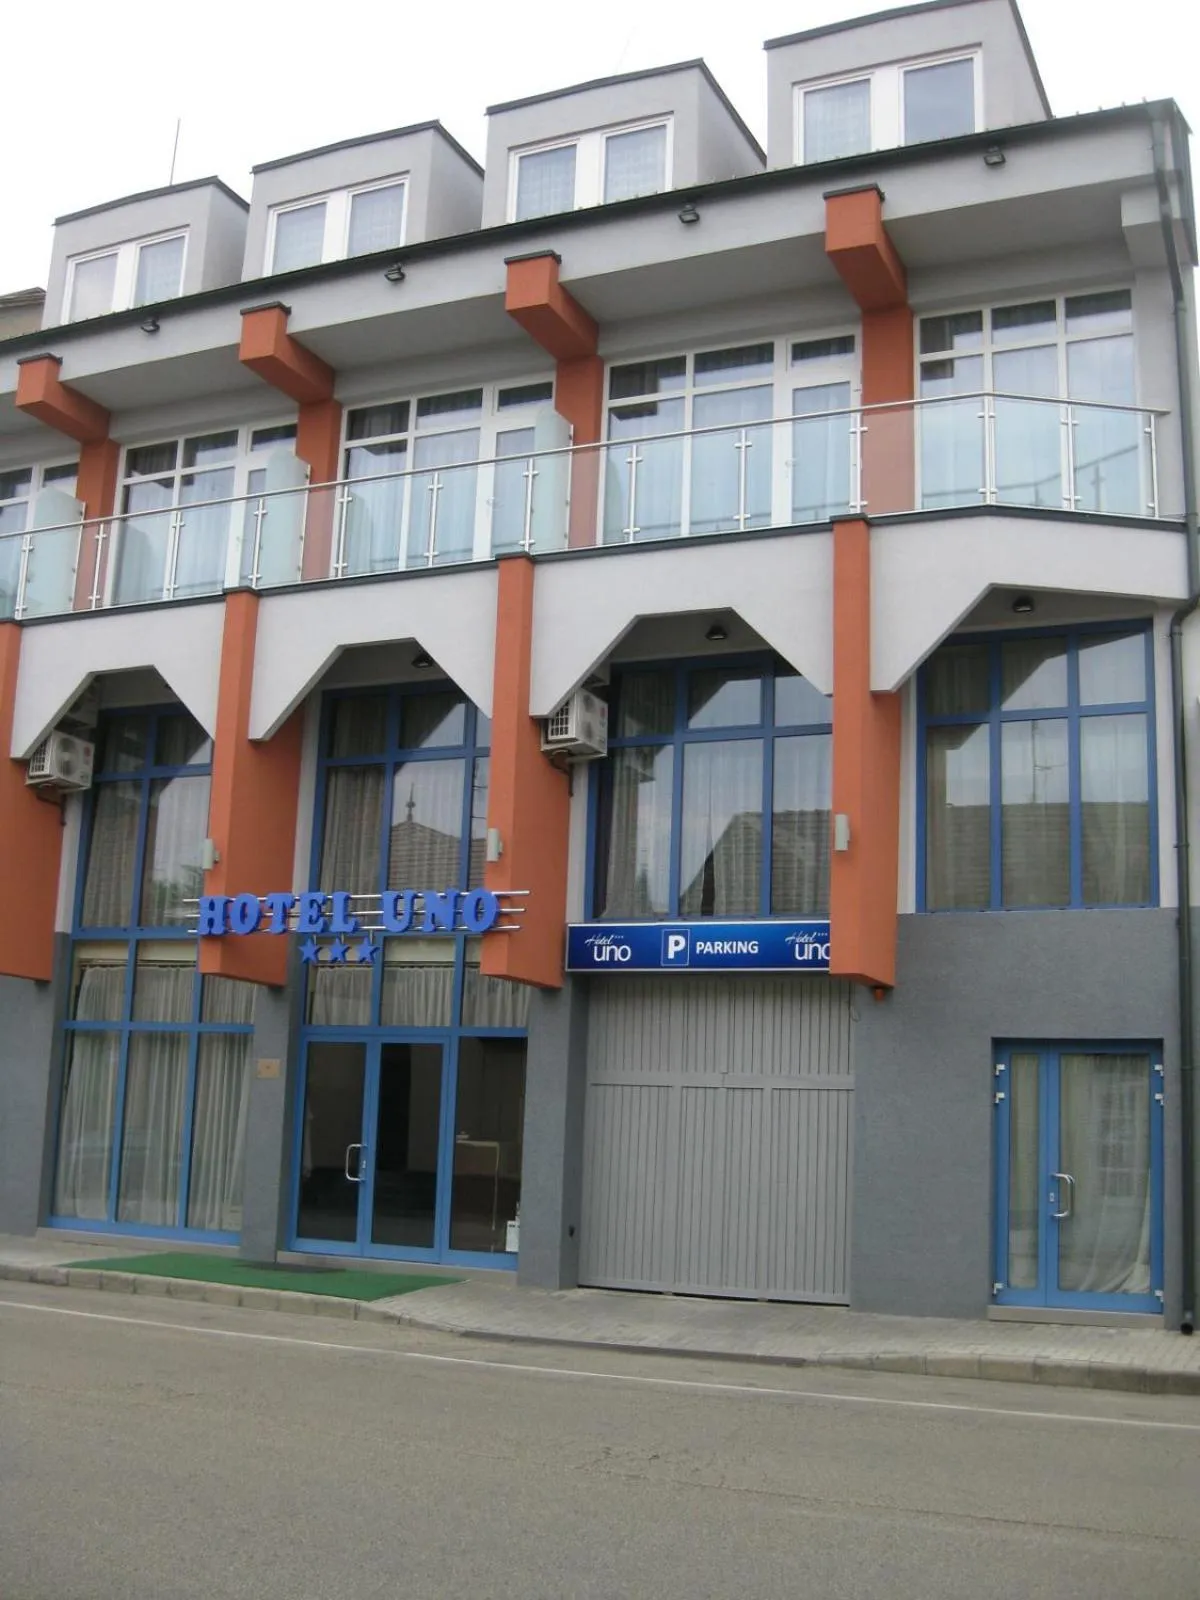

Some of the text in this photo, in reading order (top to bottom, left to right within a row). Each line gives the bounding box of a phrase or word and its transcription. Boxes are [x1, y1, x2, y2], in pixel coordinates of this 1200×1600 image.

[199, 887, 501, 935] HOTEL UNO
[584, 933, 614, 947] Hotel
[785, 930, 817, 944] Hotel
[594, 945, 631, 961] uno
[668, 935, 759, 959] P PARKING
